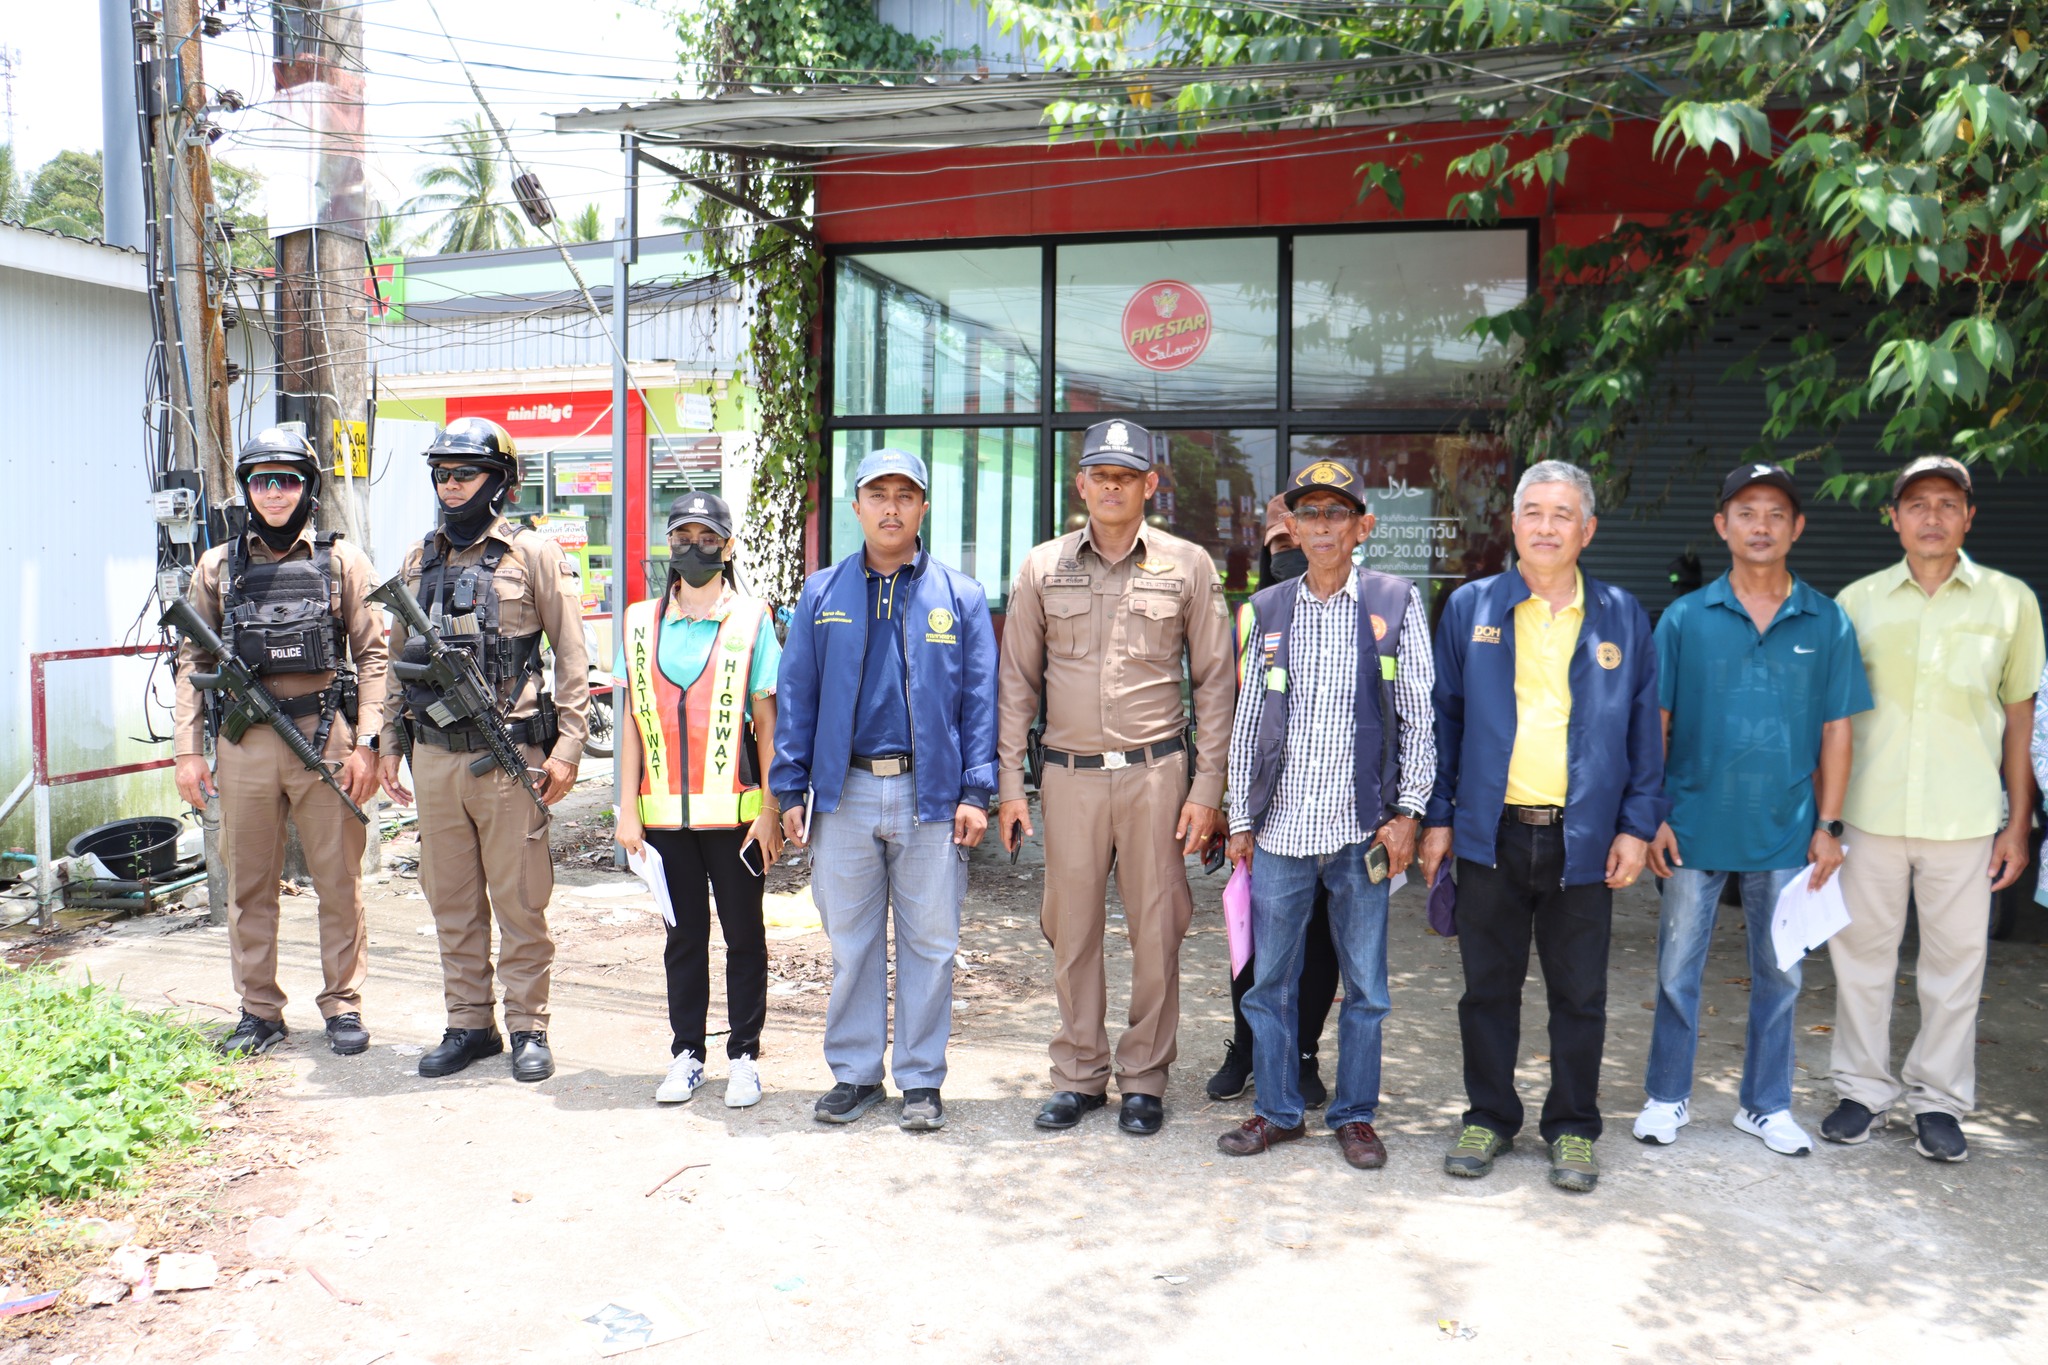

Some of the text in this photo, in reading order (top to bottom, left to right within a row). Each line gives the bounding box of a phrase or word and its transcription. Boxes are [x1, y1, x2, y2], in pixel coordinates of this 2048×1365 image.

[1130, 313, 1206, 346] FIVE STAR
[1146, 337, 1200, 361] Salam
[507, 406, 537, 421] mini
[1378, 475, 1424, 500] حلال
[1381, 514, 1419, 522] ยินดีต้อนรับ
[1474, 625, 1501, 637] DOH
[270, 646, 302, 660] POLICE
[633, 626, 661, 779] NARATHIWAT
[714, 659, 736, 775] HIGHWAY
